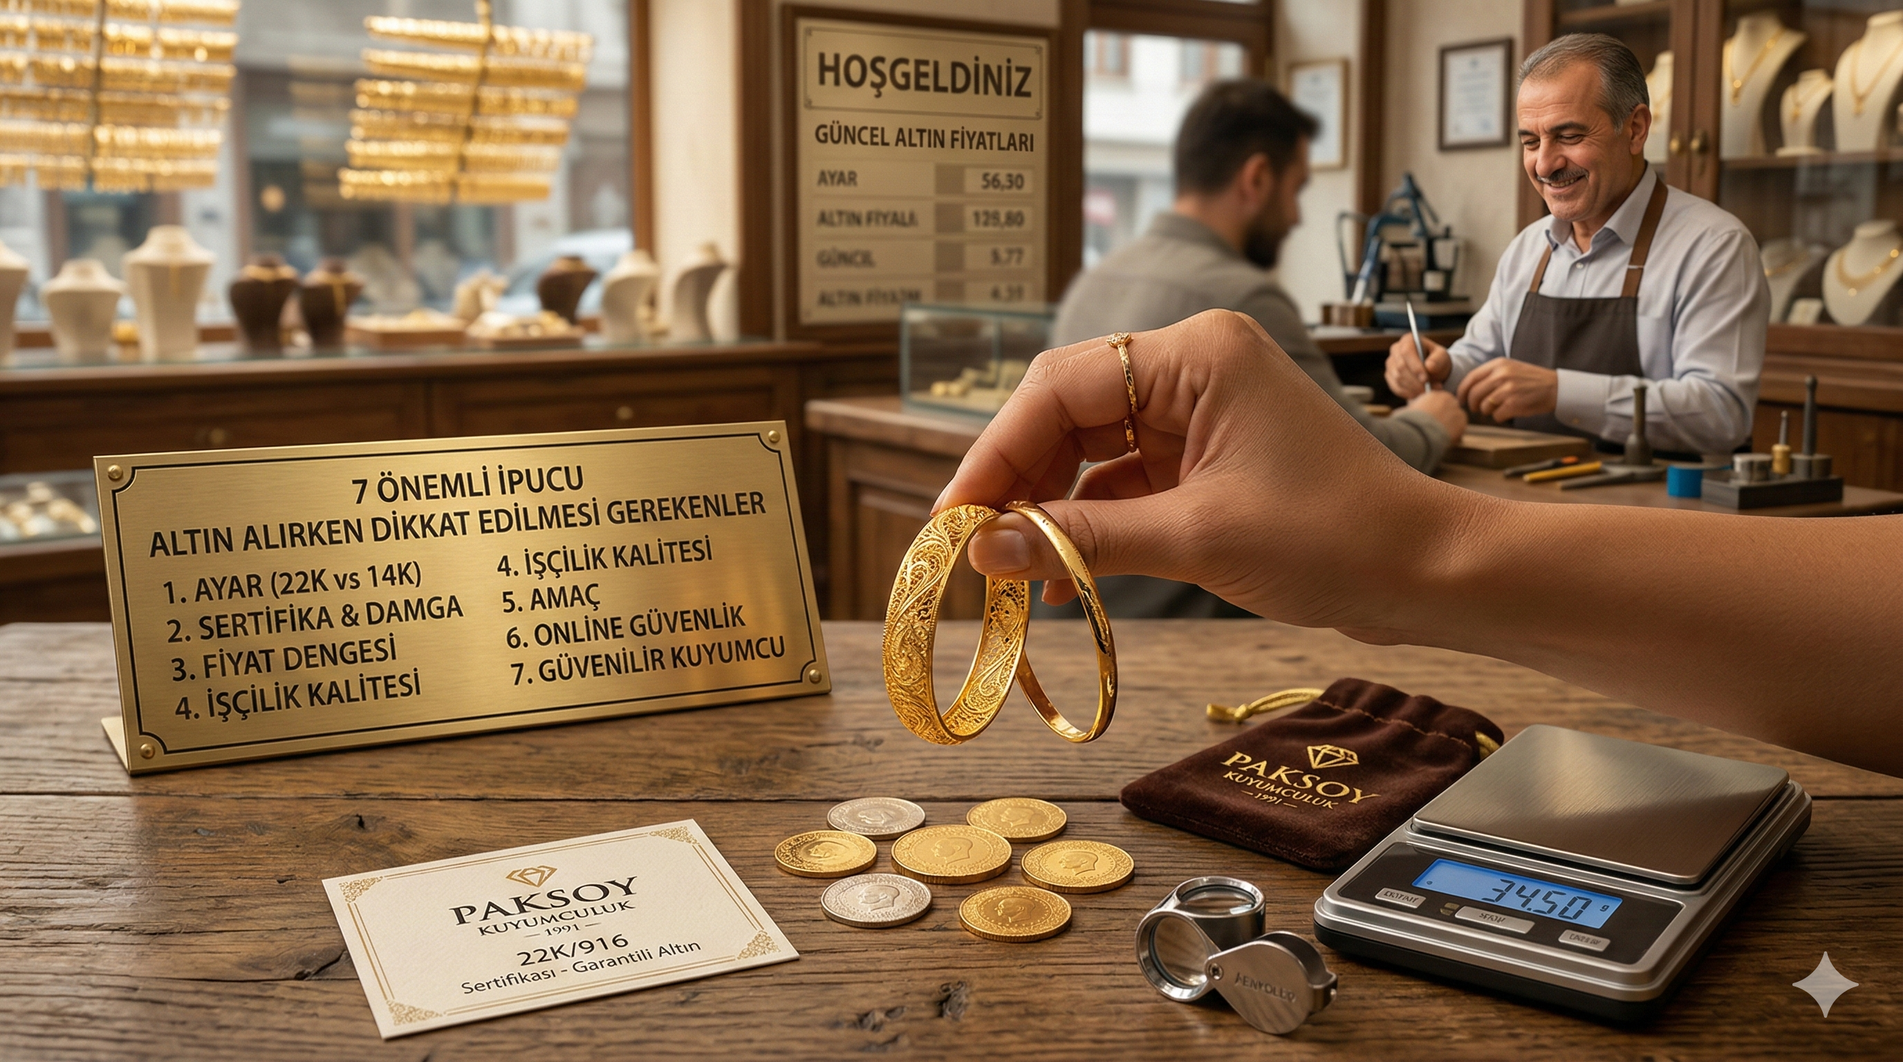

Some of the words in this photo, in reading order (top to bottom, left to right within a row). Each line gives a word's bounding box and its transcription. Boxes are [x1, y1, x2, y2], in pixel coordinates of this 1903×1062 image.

[817, 51, 1033, 98] HOŞGELDİNİZ
[814, 120, 891, 147] GÜNCEL
[894, 127, 946, 150] ALTIN
[950, 126, 1035, 152] FİYATLARI
[817, 170, 858, 187] AYAR
[981, 172, 1025, 192] 56,30
[817, 210, 862, 227] ALTIN
[351, 478, 369, 504] 7
[377, 464, 491, 503] ÖNEMLİ
[497, 464, 585, 496] İPUCU
[149, 526, 234, 558] ALTIN
[242, 518, 365, 551] ALIRKEN
[371, 510, 471, 542] DİKKAT
[478, 497, 600, 535] EDİLMESİ
[606, 491, 767, 525] GEREKENLER
[497, 555, 519, 577] 4.
[524, 543, 608, 580] İŞÇİLİK
[613, 534, 713, 568] KALİTESİ
[163, 581, 187, 604] 1.
[194, 573, 264, 602] AYAR
[270, 568, 329, 599] (22K
[333, 571, 361, 591] vs
[366, 561, 422, 588] 14K)
[502, 591, 523, 613] 5.
[529, 583, 601, 611] AMAÇ
[166, 619, 192, 643] 2.
[198, 603, 334, 640] SERTİFİKA
[340, 603, 361, 628] &
[366, 594, 464, 626] DAMGA
[506, 627, 529, 649] 6.
[533, 614, 624, 647] ONLİNE
[629, 601, 747, 637] GÜVENLİK
[171, 658, 196, 682] 3.
[203, 648, 275, 679] FİYAT
[283, 632, 397, 671] DENGESİ
[510, 663, 533, 686] 7.
[538, 645, 666, 683] GÜVENİLİR
[670, 635, 786, 669] KUYUMCU
[175, 697, 200, 720] 4.
[208, 681, 302, 723] İŞÇİLİK
[307, 667, 422, 707] KALİTESİ
[1220, 751, 1381, 805] PAKSOY
[1222, 770, 1339, 810] KUYUMCULUK
[448, 875, 638, 926] PAKSOY
[477, 900, 636, 936] KUYUMCULUK
[1481, 878, 1593, 920] 34.50
[516, 933, 629, 967] 22K/916
[544, 923, 581, 937] 1991
[461, 968, 557, 995] Sertifikası
[572, 946, 653, 974] Garantili
[657, 940, 702, 957] Altın
